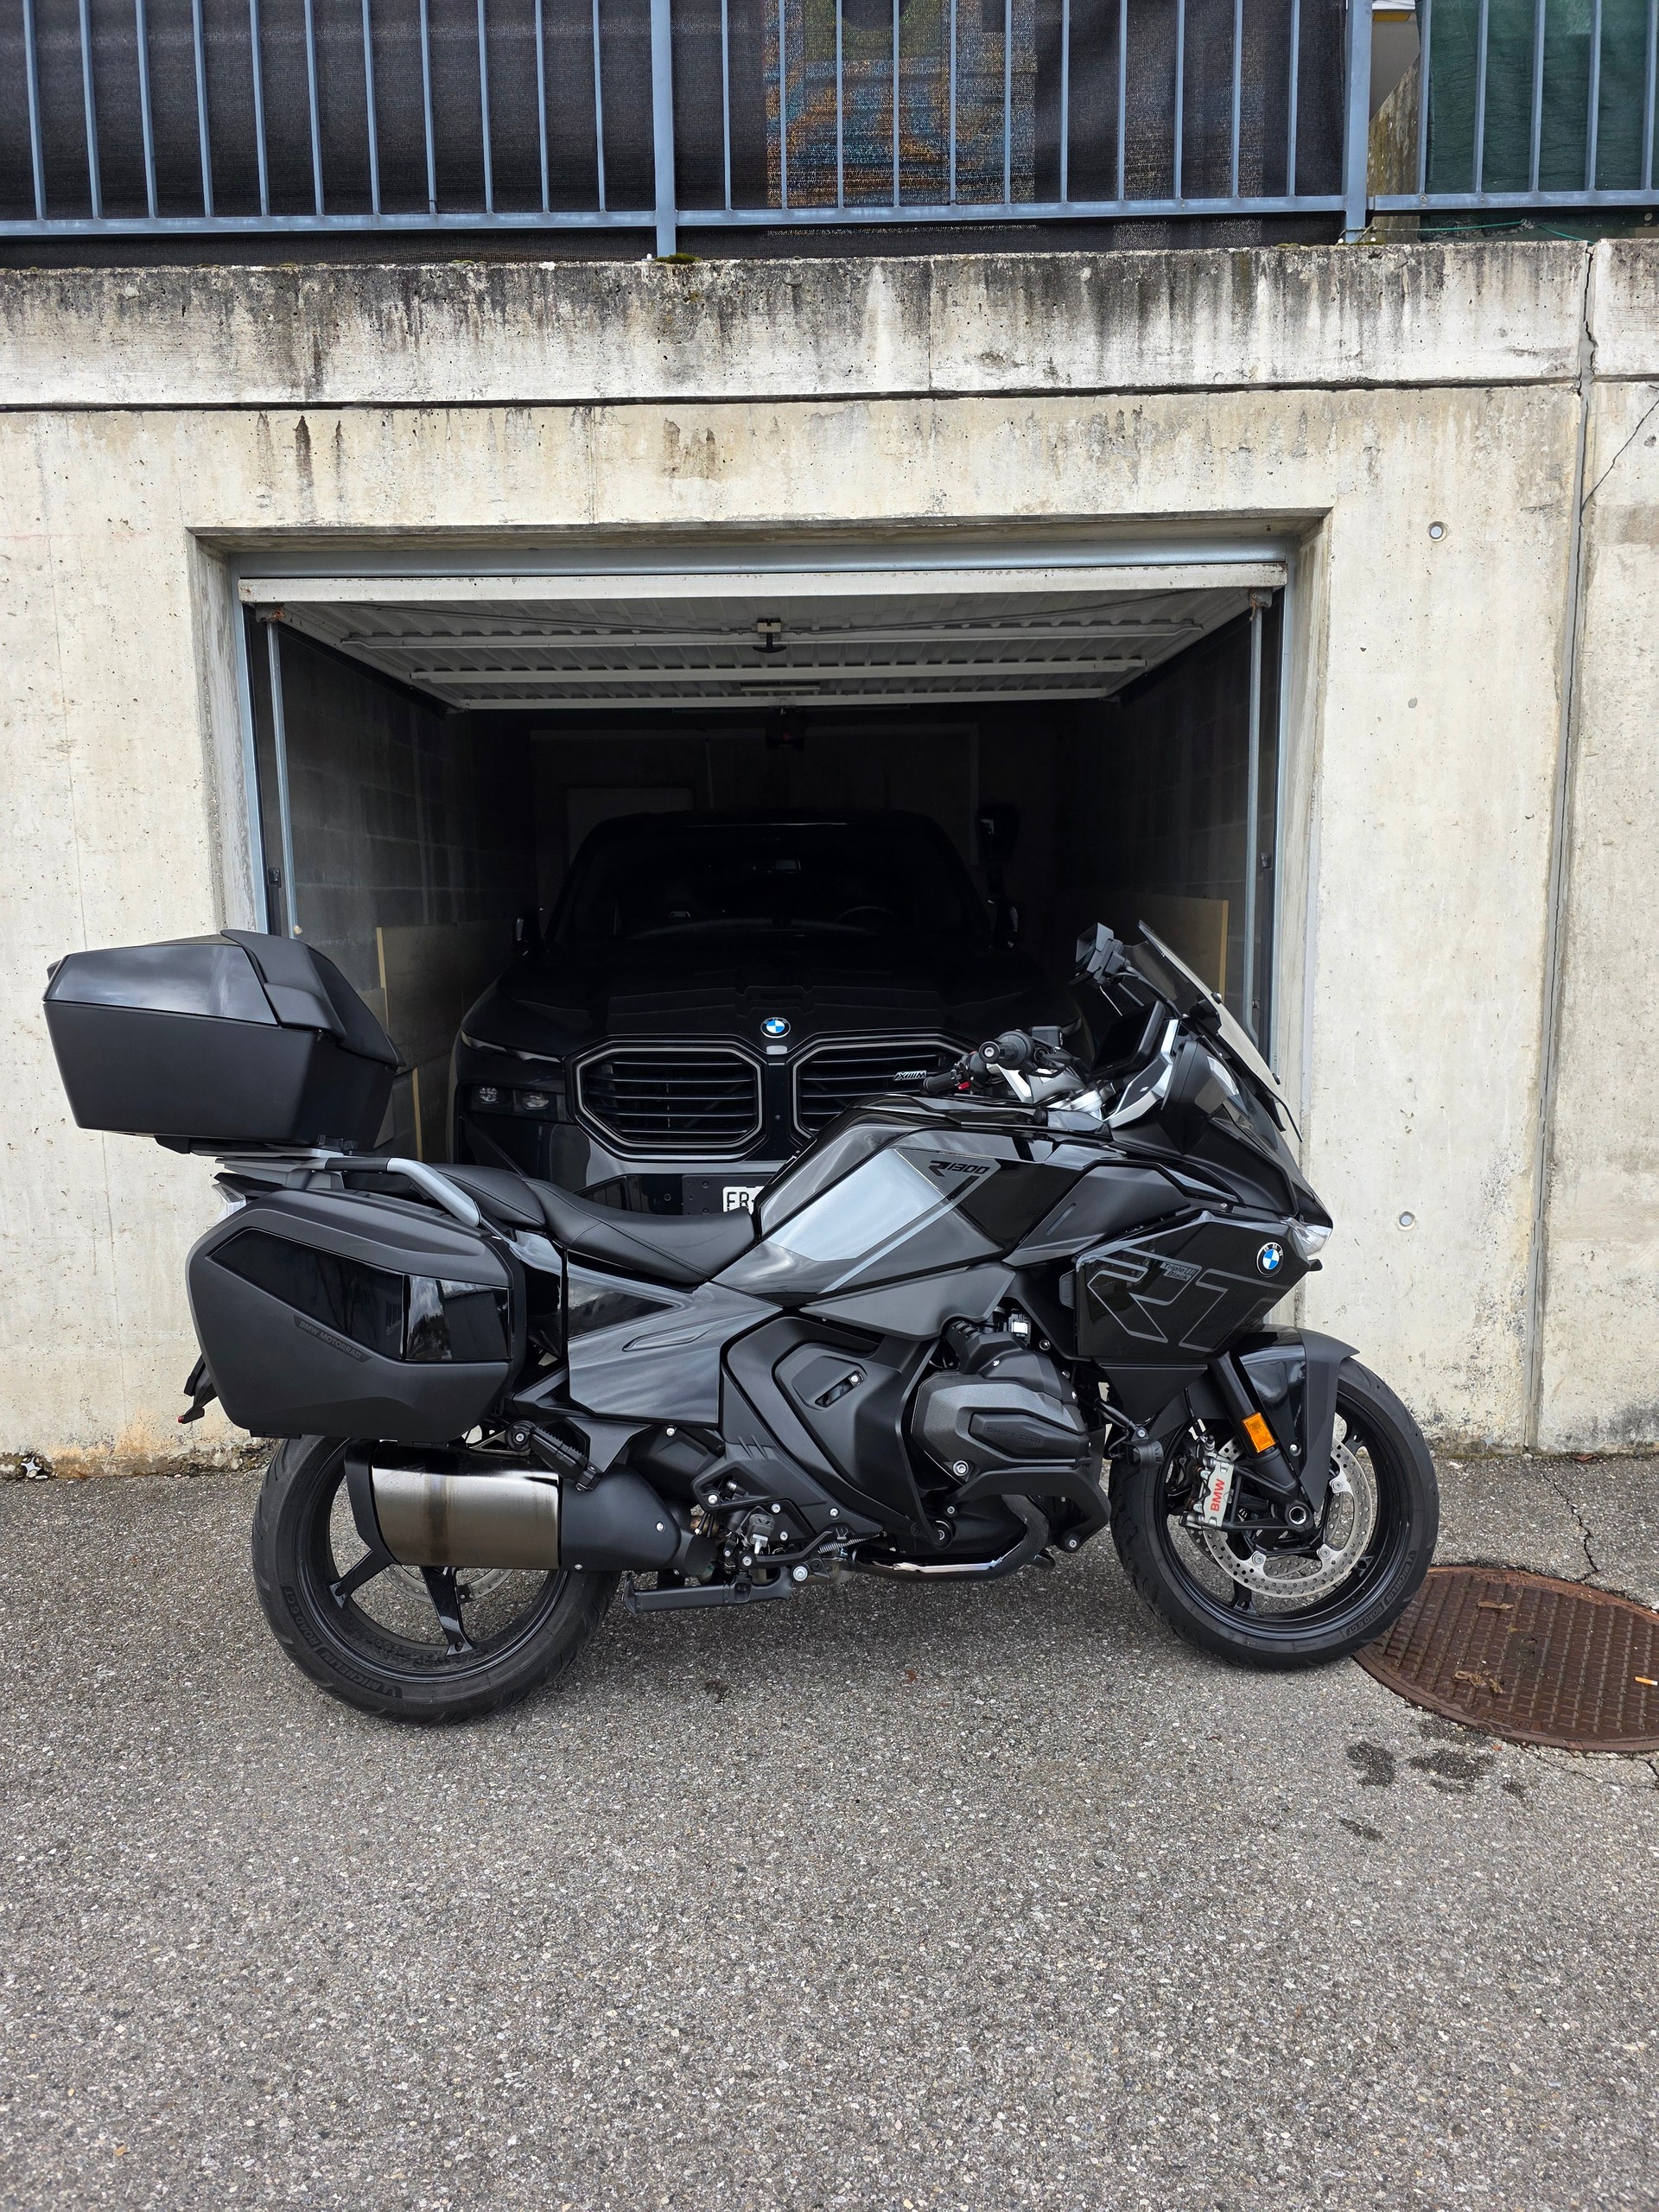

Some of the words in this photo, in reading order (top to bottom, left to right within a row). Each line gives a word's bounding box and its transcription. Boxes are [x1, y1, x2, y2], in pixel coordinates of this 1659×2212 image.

[1163, 1262, 1185, 1274] Triple
[1166, 1270, 1189, 1281] Black
[299, 1320, 320, 1336] BMW
[319, 1332, 361, 1359] MOTORRAD
[1211, 1478, 1225, 1512] BMW
[1386, 1563, 1410, 1603] MICHELIN
[286, 1592, 296, 1604] GT
[1364, 1605, 1382, 1623] ROAD
[296, 1617, 320, 1645] ROAD
